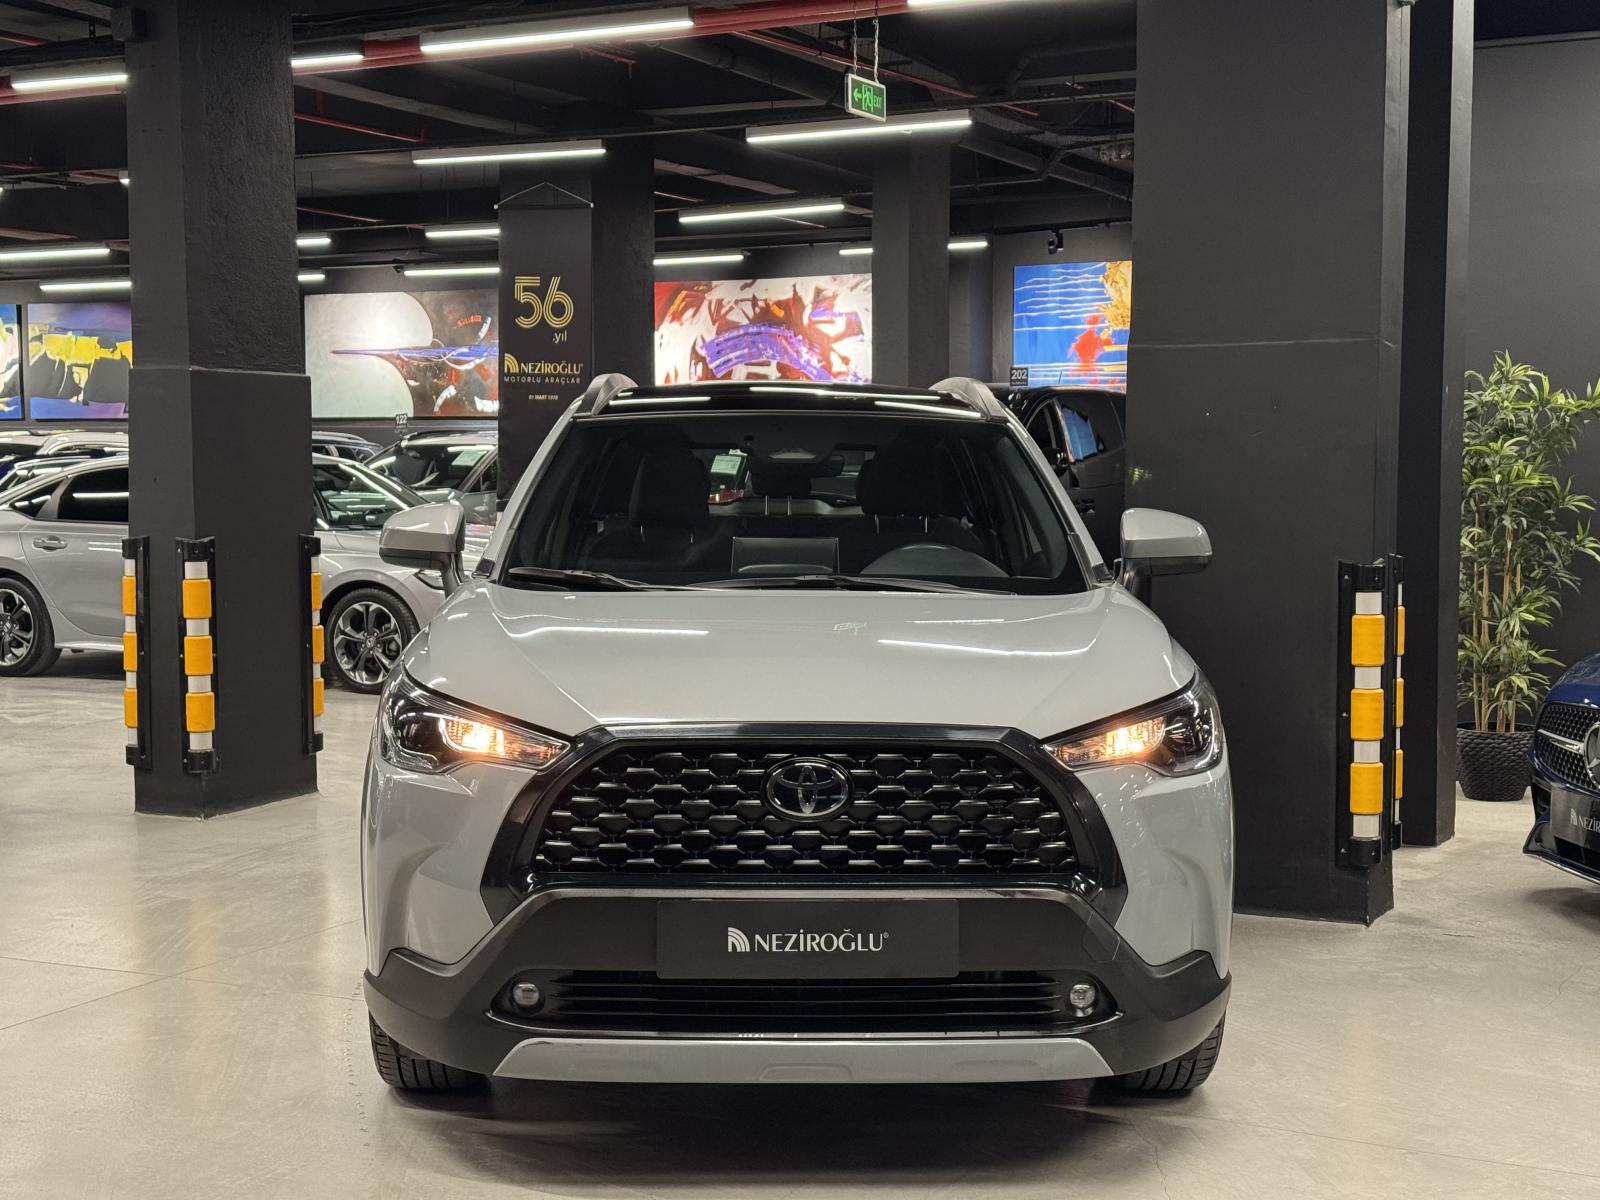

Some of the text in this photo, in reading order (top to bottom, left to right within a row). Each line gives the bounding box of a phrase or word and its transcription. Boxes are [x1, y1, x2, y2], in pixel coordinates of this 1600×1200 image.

[874, 95, 883, 109] EXIT
[514, 276, 574, 328] 56
[520, 360, 581, 375] NEZİROĞLU
[1011, 369, 1027, 380] 202
[504, 375, 581, 385] MOTORLU ARAÇLAR
[396, 414, 408, 424] 122
[755, 929, 883, 952] NEZİROĞLU
